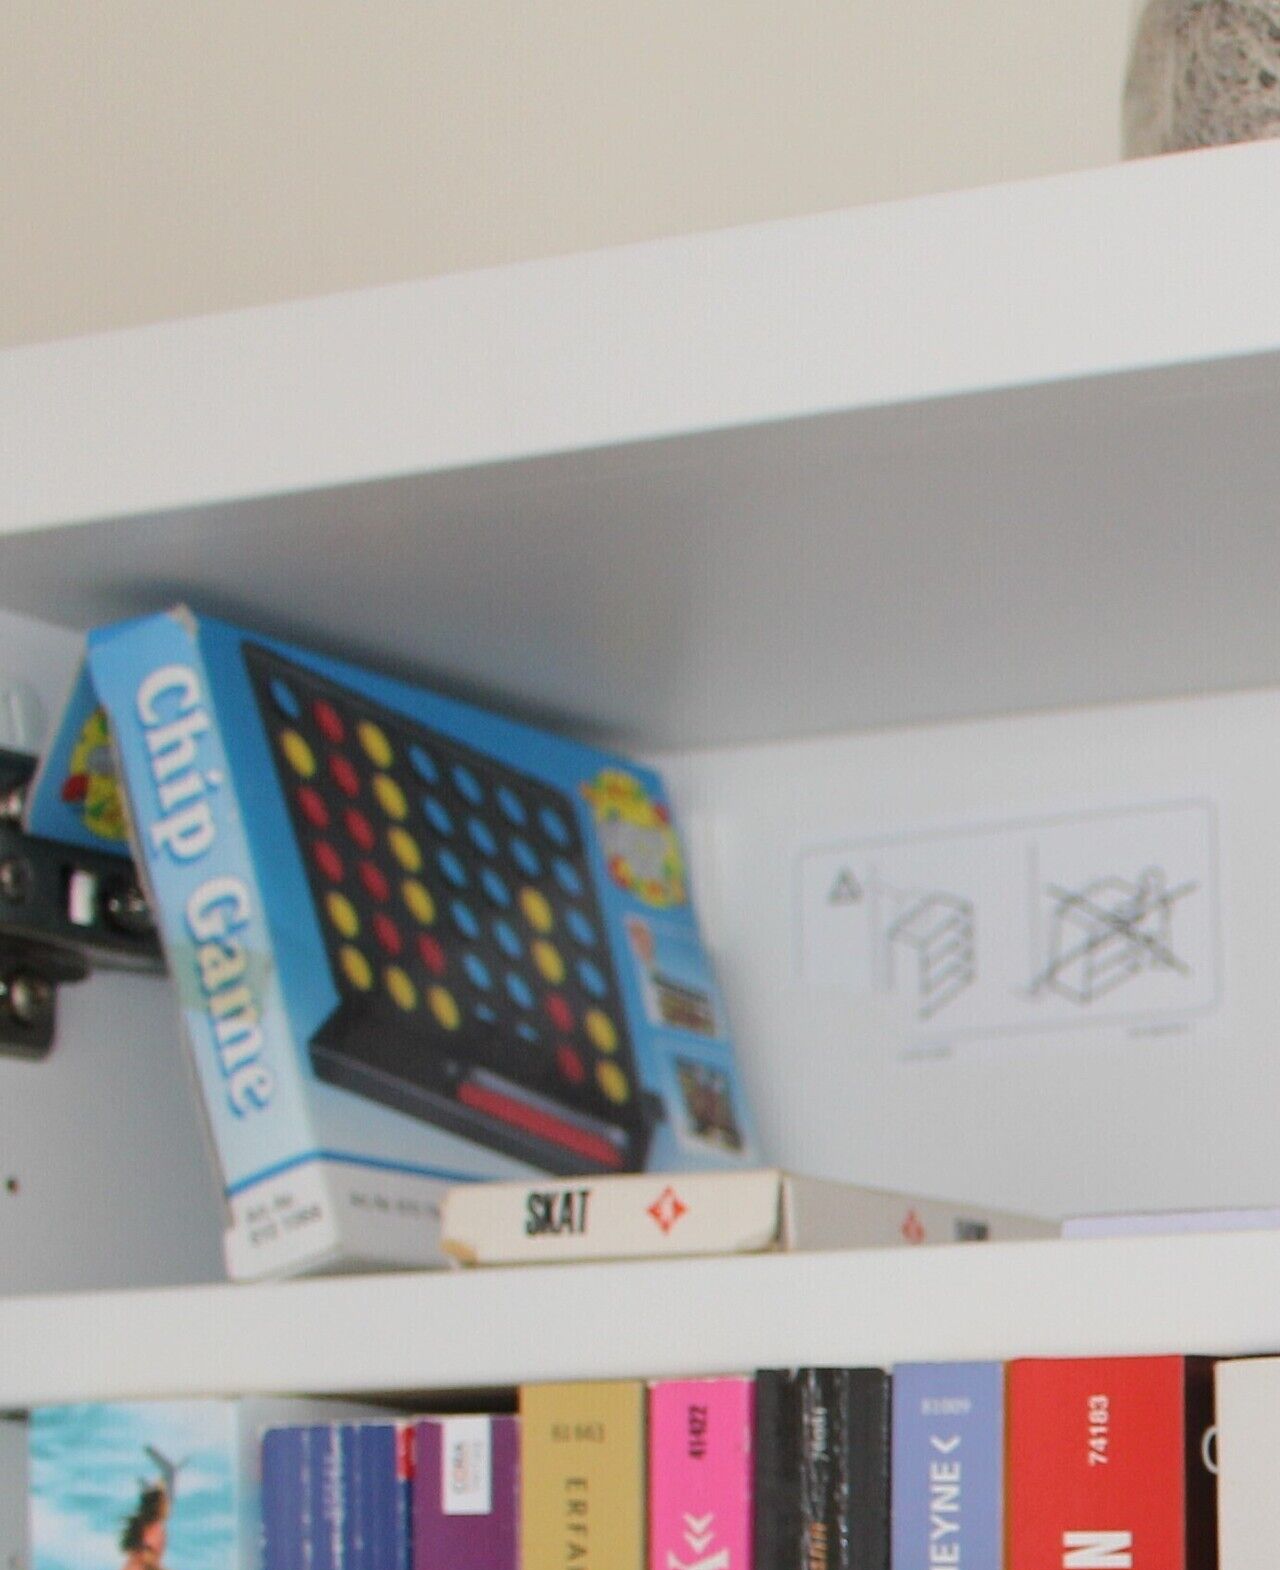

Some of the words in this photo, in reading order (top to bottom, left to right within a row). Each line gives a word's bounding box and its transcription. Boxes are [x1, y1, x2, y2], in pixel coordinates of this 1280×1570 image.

[136, 663, 232, 863] Chip
[180, 876, 275, 1121] Game
[524, 1189, 592, 1236] SKAT
[1087, 1393, 1110, 1467] 74183
